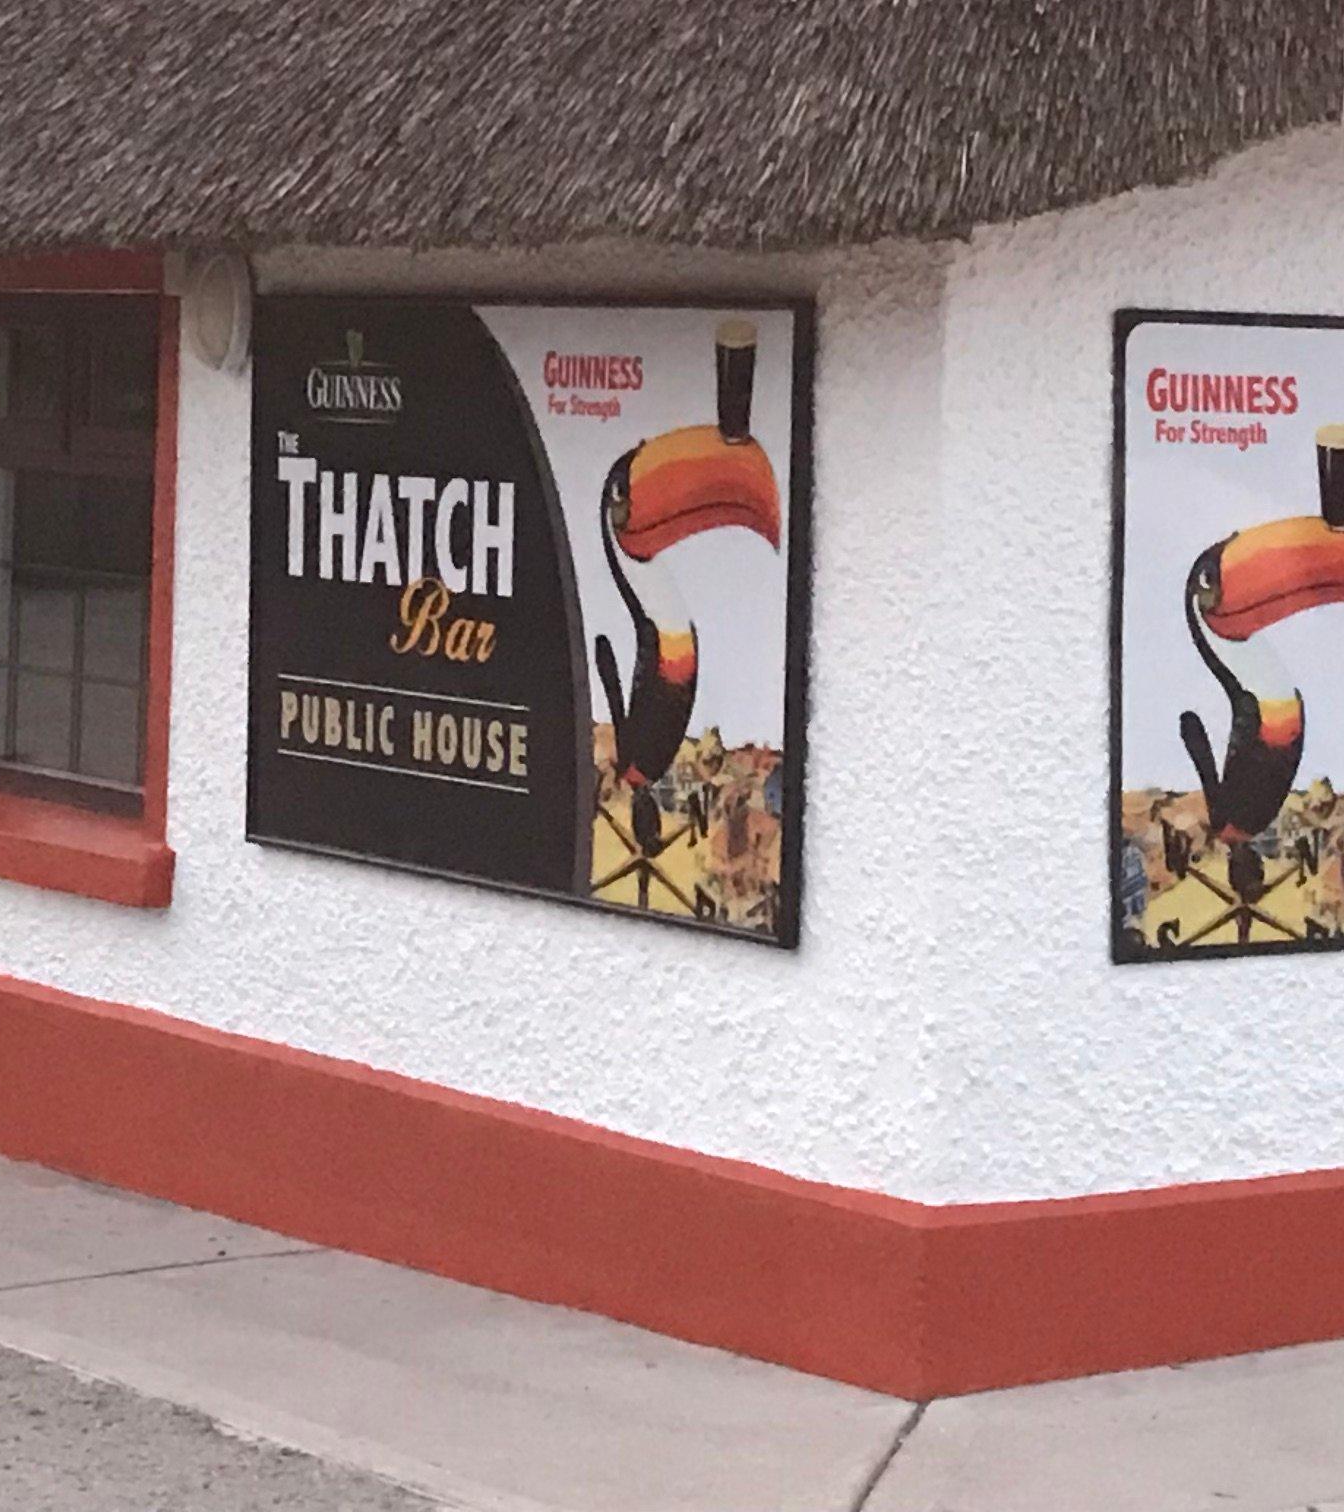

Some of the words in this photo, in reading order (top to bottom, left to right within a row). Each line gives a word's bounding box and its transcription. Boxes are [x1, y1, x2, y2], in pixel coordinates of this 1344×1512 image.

[307, 367, 403, 411] GUINNESS
[543, 350, 644, 390] GUINNESS
[1146, 368, 1299, 415] GUINNESS
[1155, 418, 1186, 444] For
[1190, 419, 1268, 452] Strength
[278, 456, 515, 598] THATCH
[390, 577, 497, 663] Bar
[280, 690, 395, 756] PUBLIC
[412, 708, 528, 777] HOUSE
